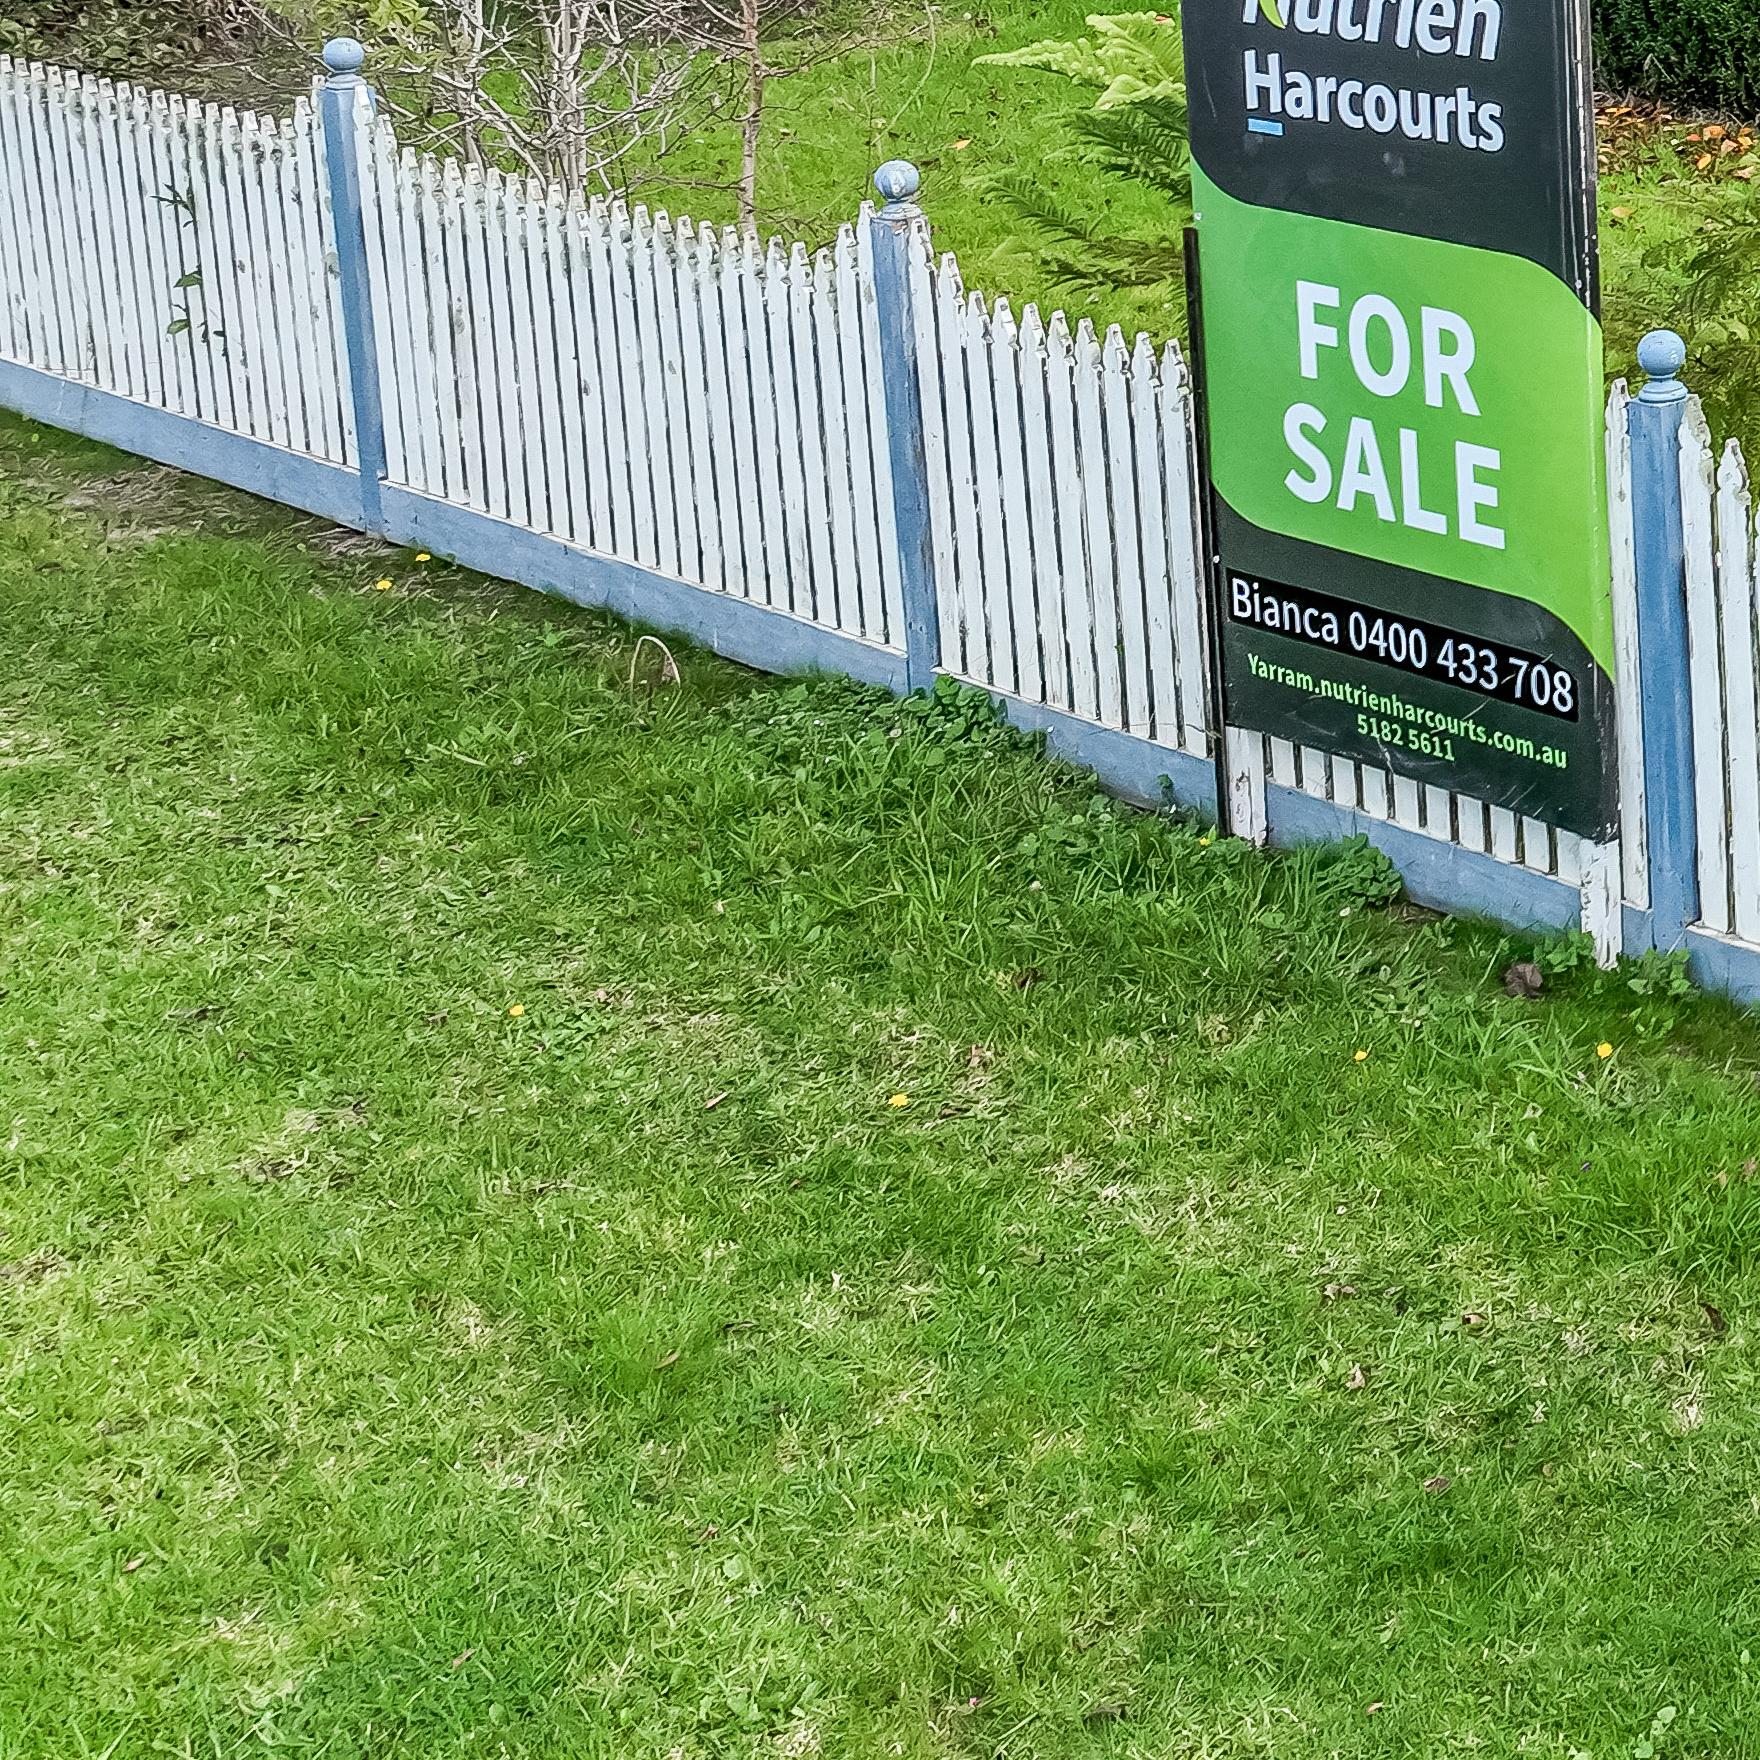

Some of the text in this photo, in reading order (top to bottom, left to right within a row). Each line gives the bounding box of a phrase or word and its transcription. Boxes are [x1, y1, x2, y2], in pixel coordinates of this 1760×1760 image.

[1244, 50, 1504, 152] Harcourts
[1296, 280, 1481, 416] FOR
[1283, 402, 1505, 550] SALE
[1231, 577, 1574, 713] Bianca 0400 433 708
[1247, 652, 1568, 769] Yarram.nutrienharcourts.com.au
[1357, 713, 1456, 762] 5182 5611
